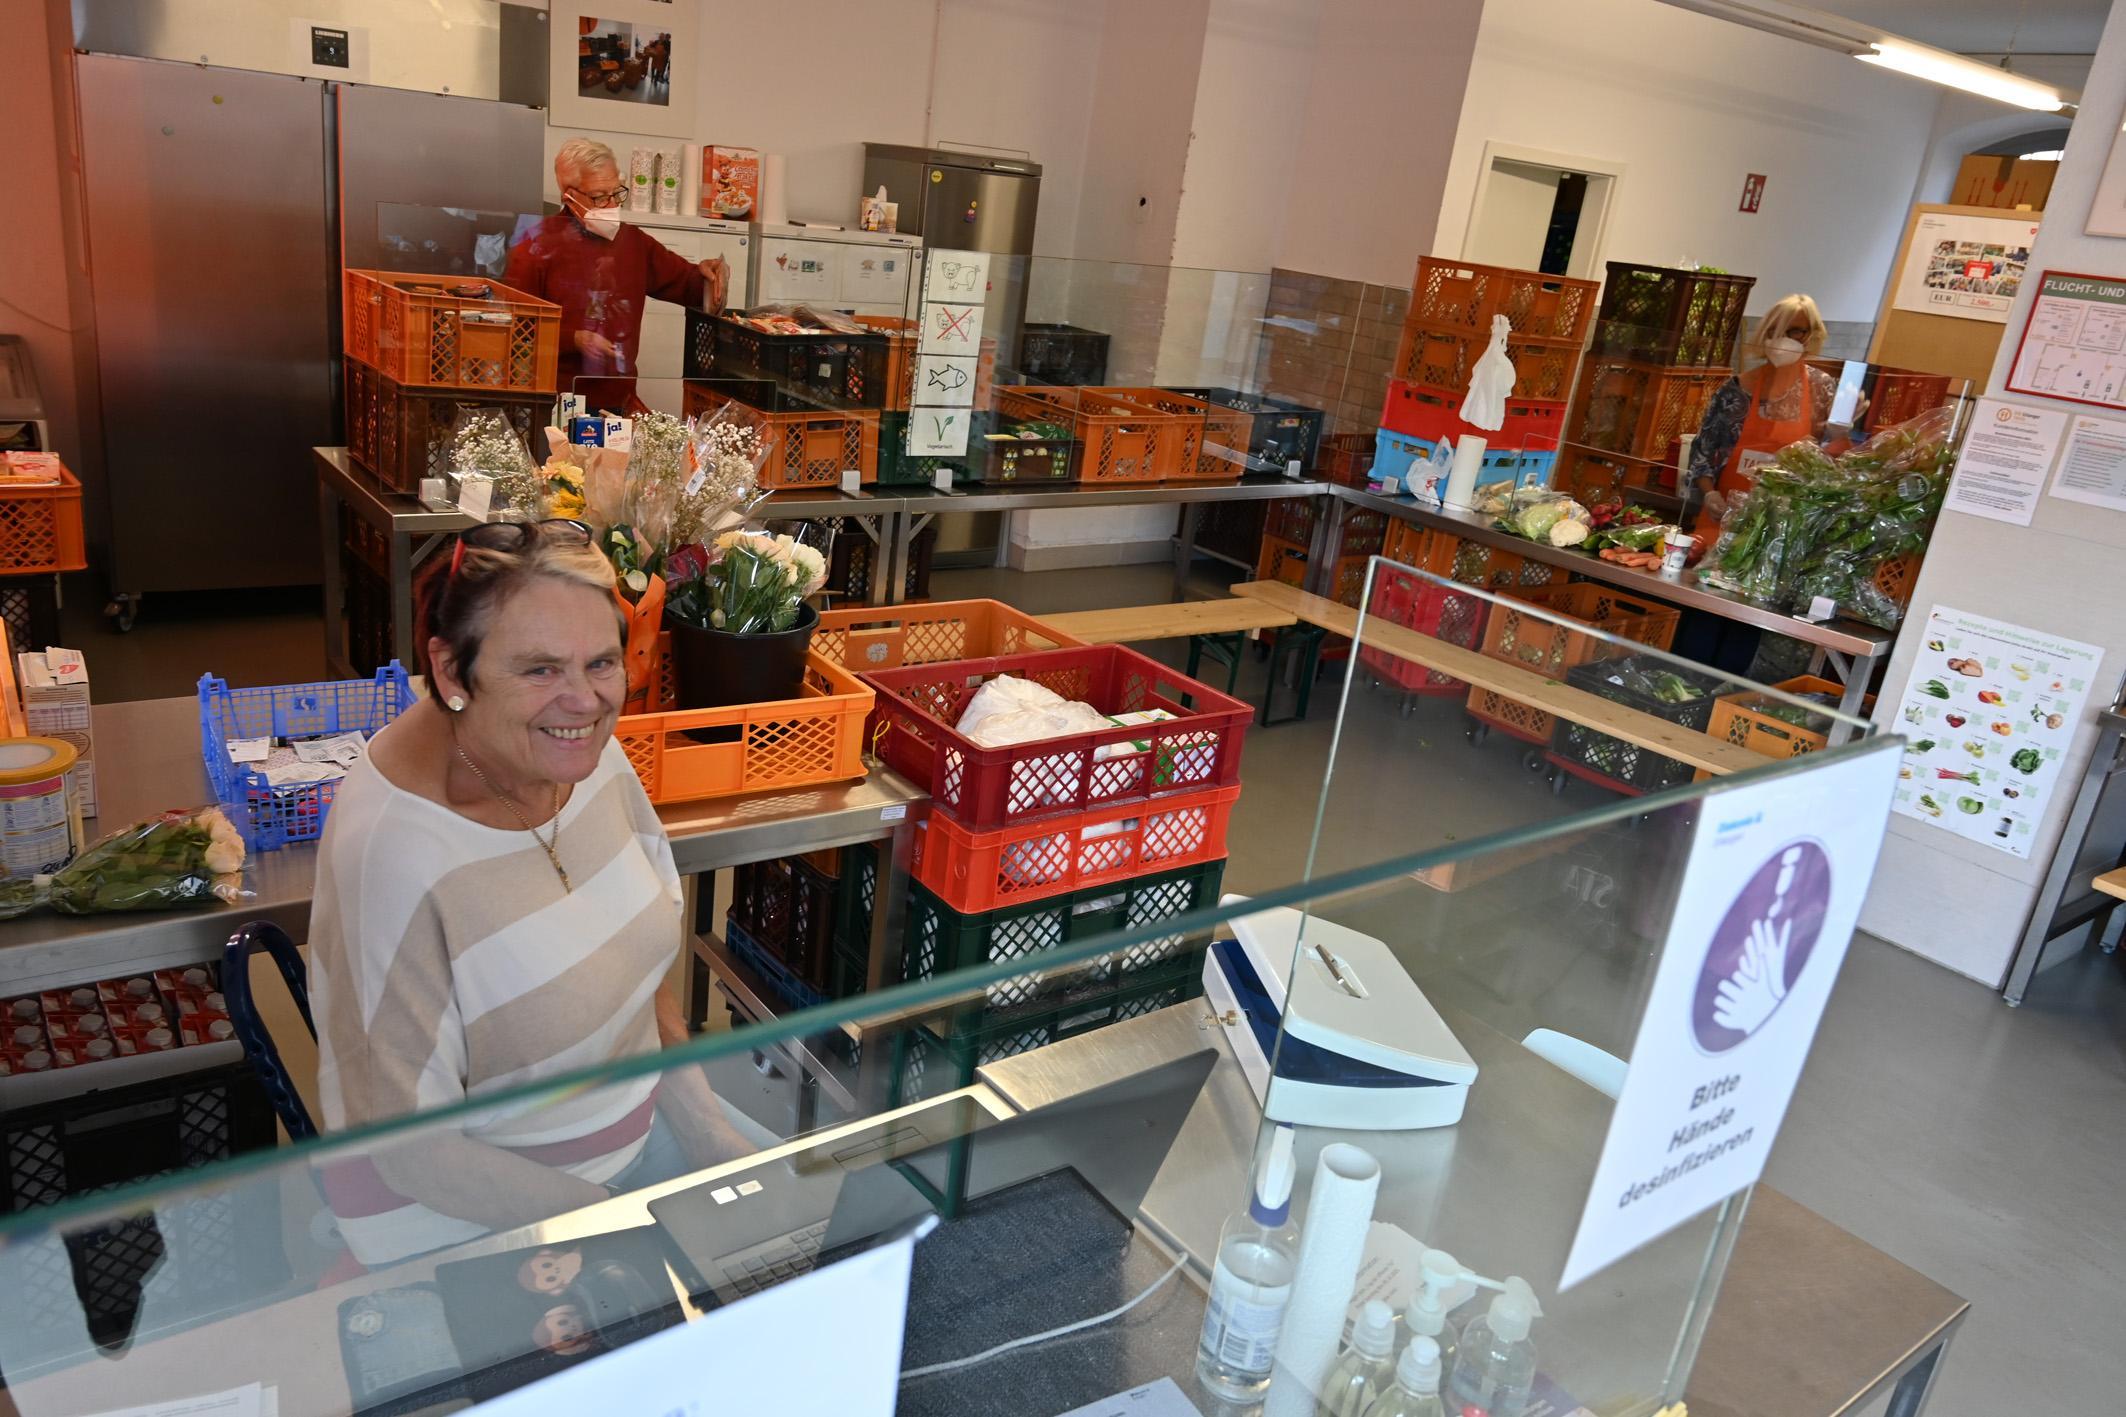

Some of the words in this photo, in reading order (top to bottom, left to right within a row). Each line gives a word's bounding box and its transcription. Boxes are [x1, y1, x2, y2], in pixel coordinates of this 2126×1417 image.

[1934, 293, 1952, 303] EUR
[2044, 280, 2096, 294] FLUCHT-
[2098, 286, 2125, 298] UND
[564, 398, 576, 412] ja!
[607, 422, 622, 436] ja!
[1689, 1074, 1741, 1111] Bitte
[1668, 1107, 1735, 1154] Hände
[1619, 1126, 1754, 1208] desinfizieren
